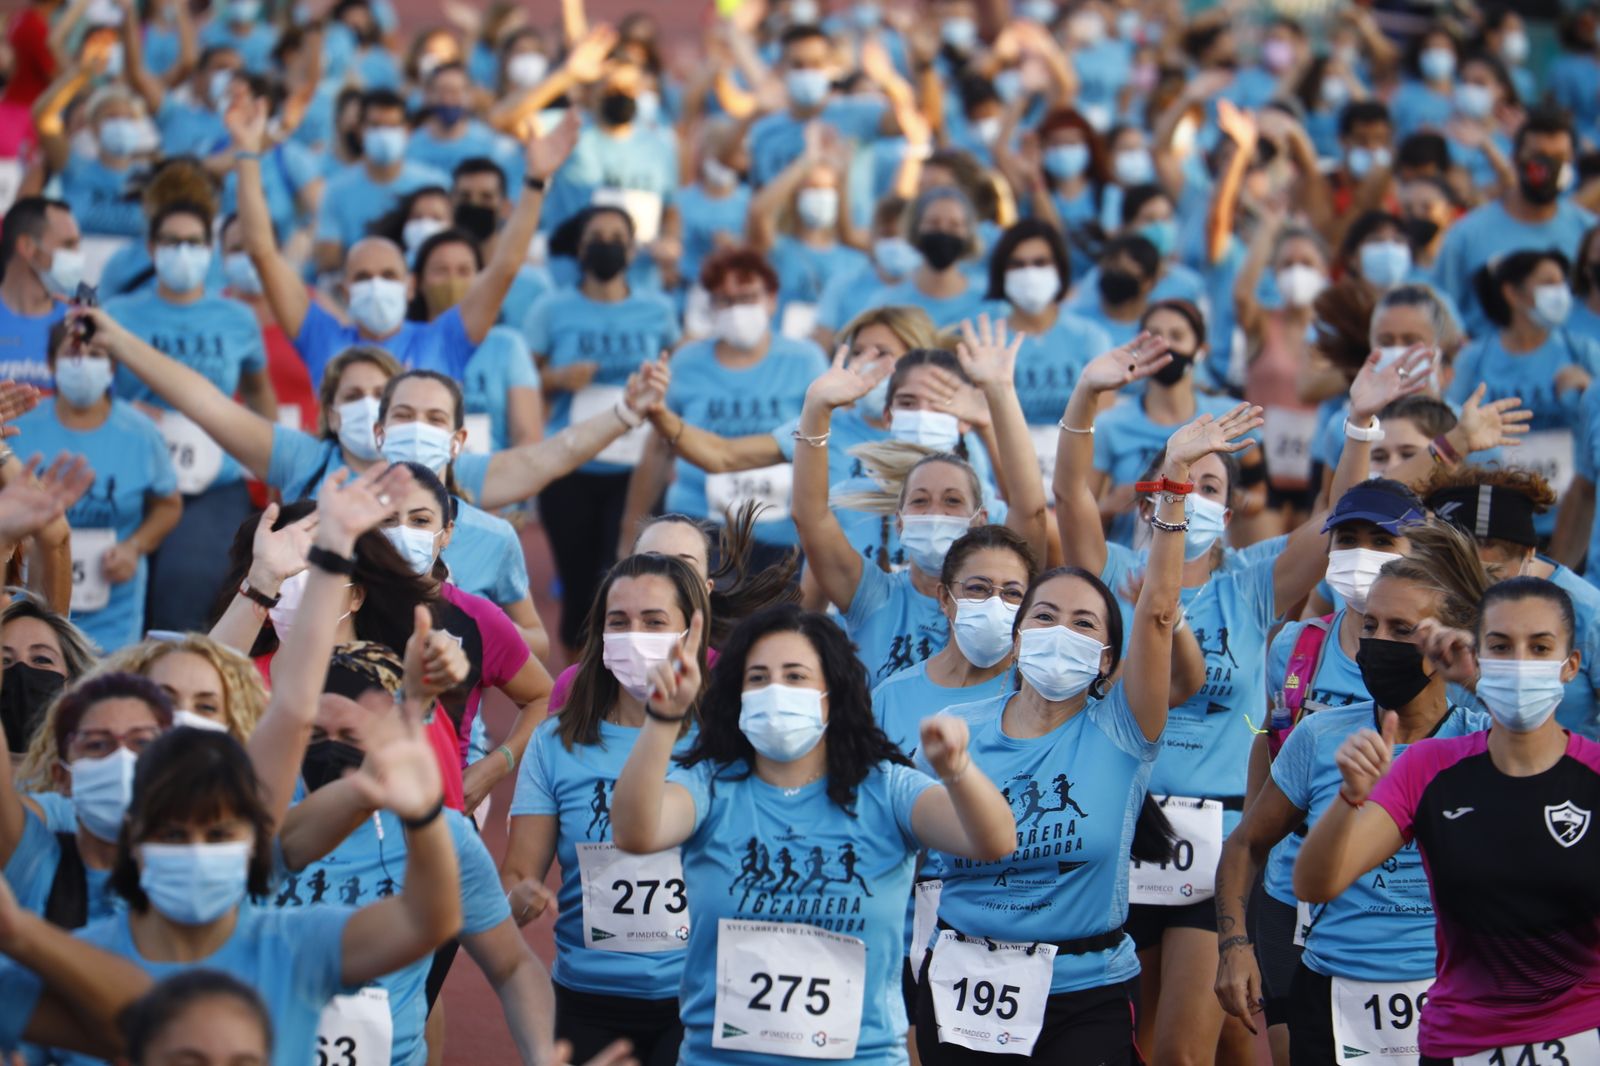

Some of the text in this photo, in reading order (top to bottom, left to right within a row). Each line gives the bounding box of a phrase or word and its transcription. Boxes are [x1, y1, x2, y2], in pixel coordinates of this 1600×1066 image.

[1144, 884, 1174, 892] IMDECO
[611, 878, 688, 915] 273
[635, 931, 668, 939] IMDECO
[743, 925, 785, 935] CARRERA
[747, 972, 830, 1016] 275
[952, 977, 1021, 1020] 195
[769, 1031, 804, 1041] IMDECO
[961, 1028, 991, 1039] IMDECO
